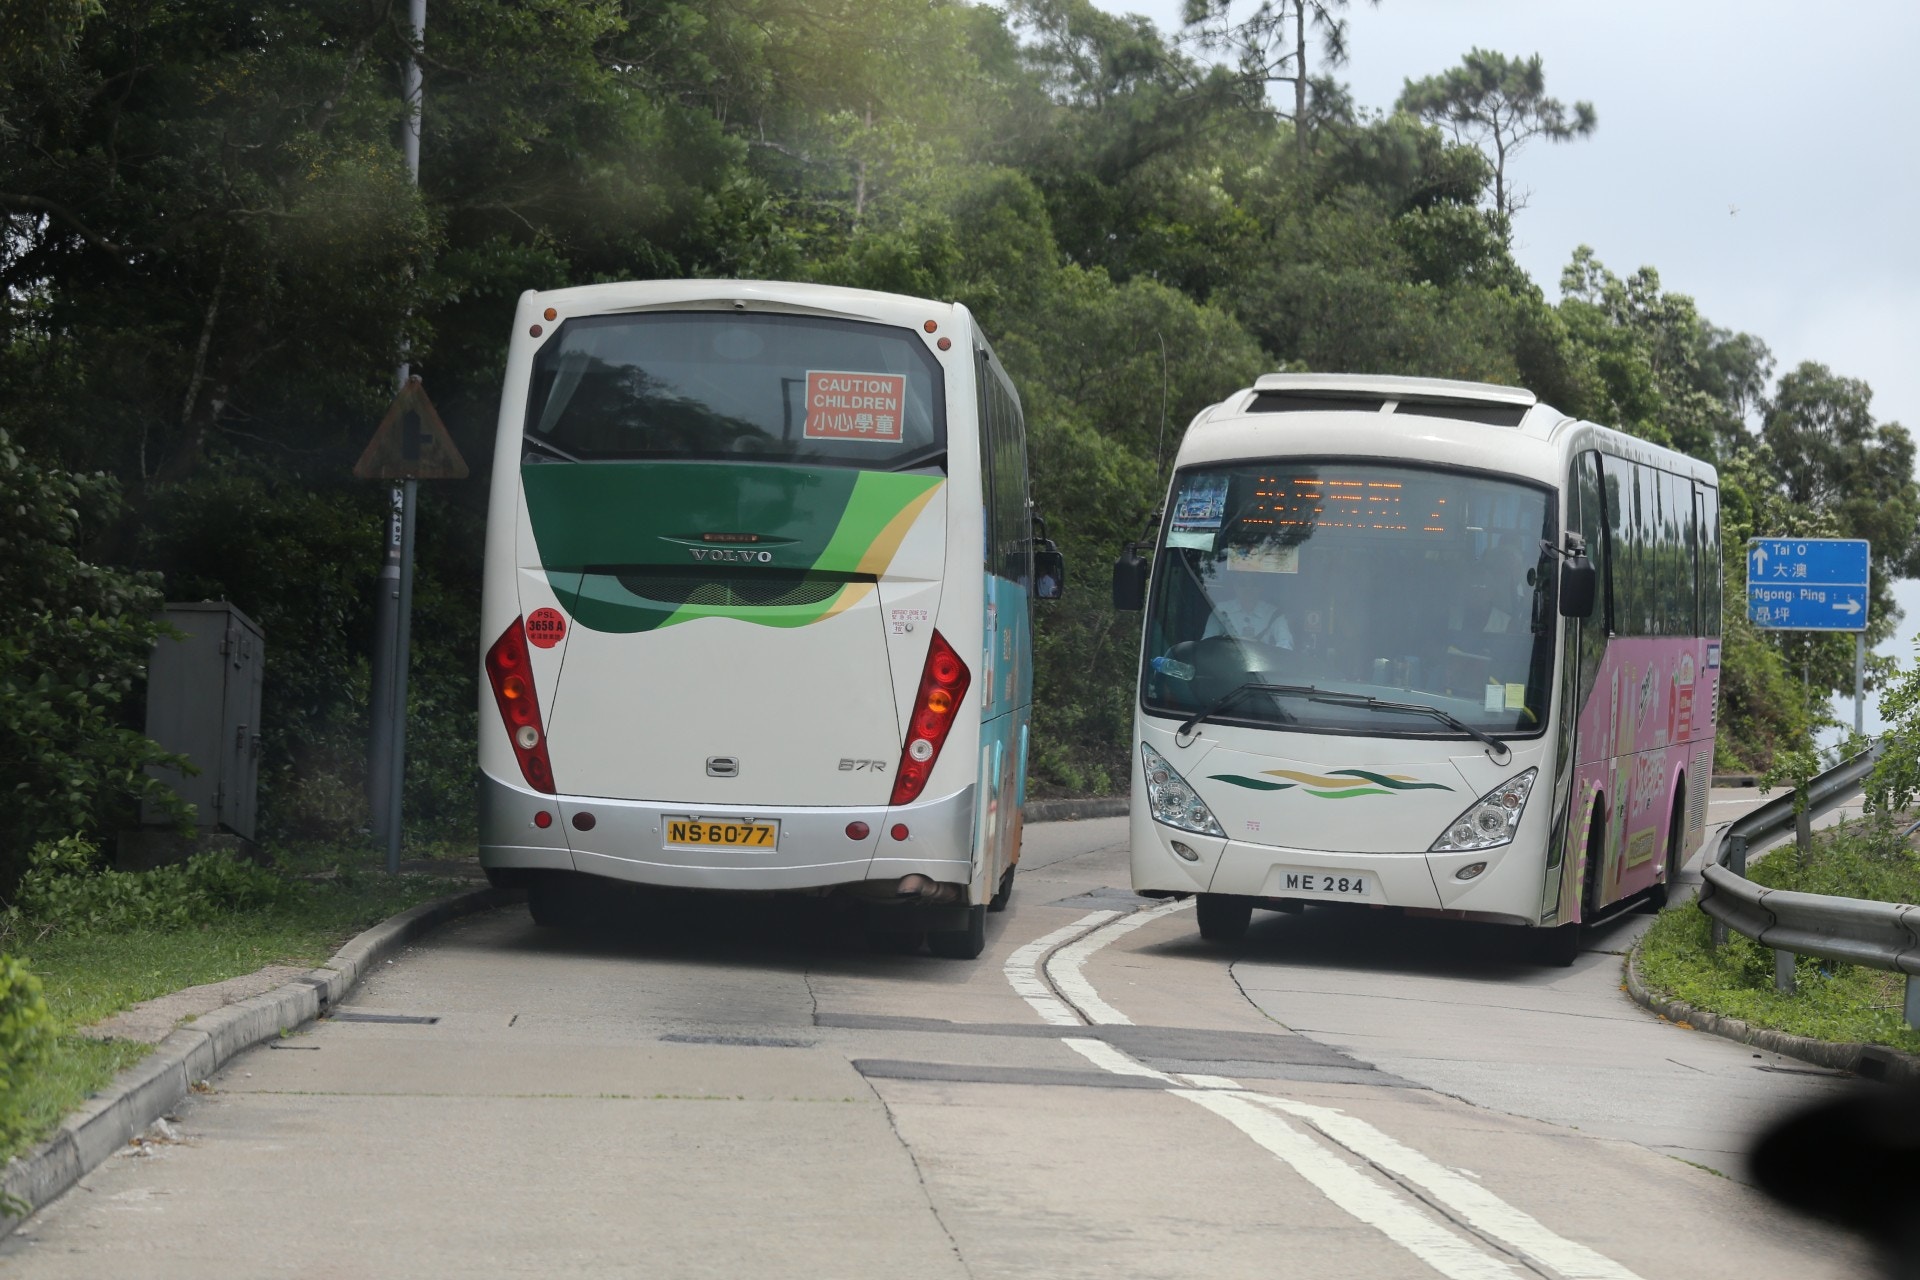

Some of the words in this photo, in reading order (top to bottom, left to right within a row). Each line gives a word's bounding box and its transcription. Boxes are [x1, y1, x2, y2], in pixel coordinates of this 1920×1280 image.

[818, 378, 892, 394] CAUTION
[814, 394, 897, 411] CHILDREN
[813, 412, 894, 434] 小心學童
[689, 548, 772, 562] VOLVO
[1773, 544, 1790, 556] Tai
[1797, 544, 1806, 556] O
[1773, 563, 1807, 578] 大澳
[1755, 588, 1792, 602] Ngong
[1800, 588, 1826, 603] Ping
[537, 611, 555, 619] PSL
[1756, 606, 1790, 622] 昂坪
[838, 759, 887, 772] B7R
[1286, 874, 1314, 890] ME
[1323, 876, 1363, 893] 284
